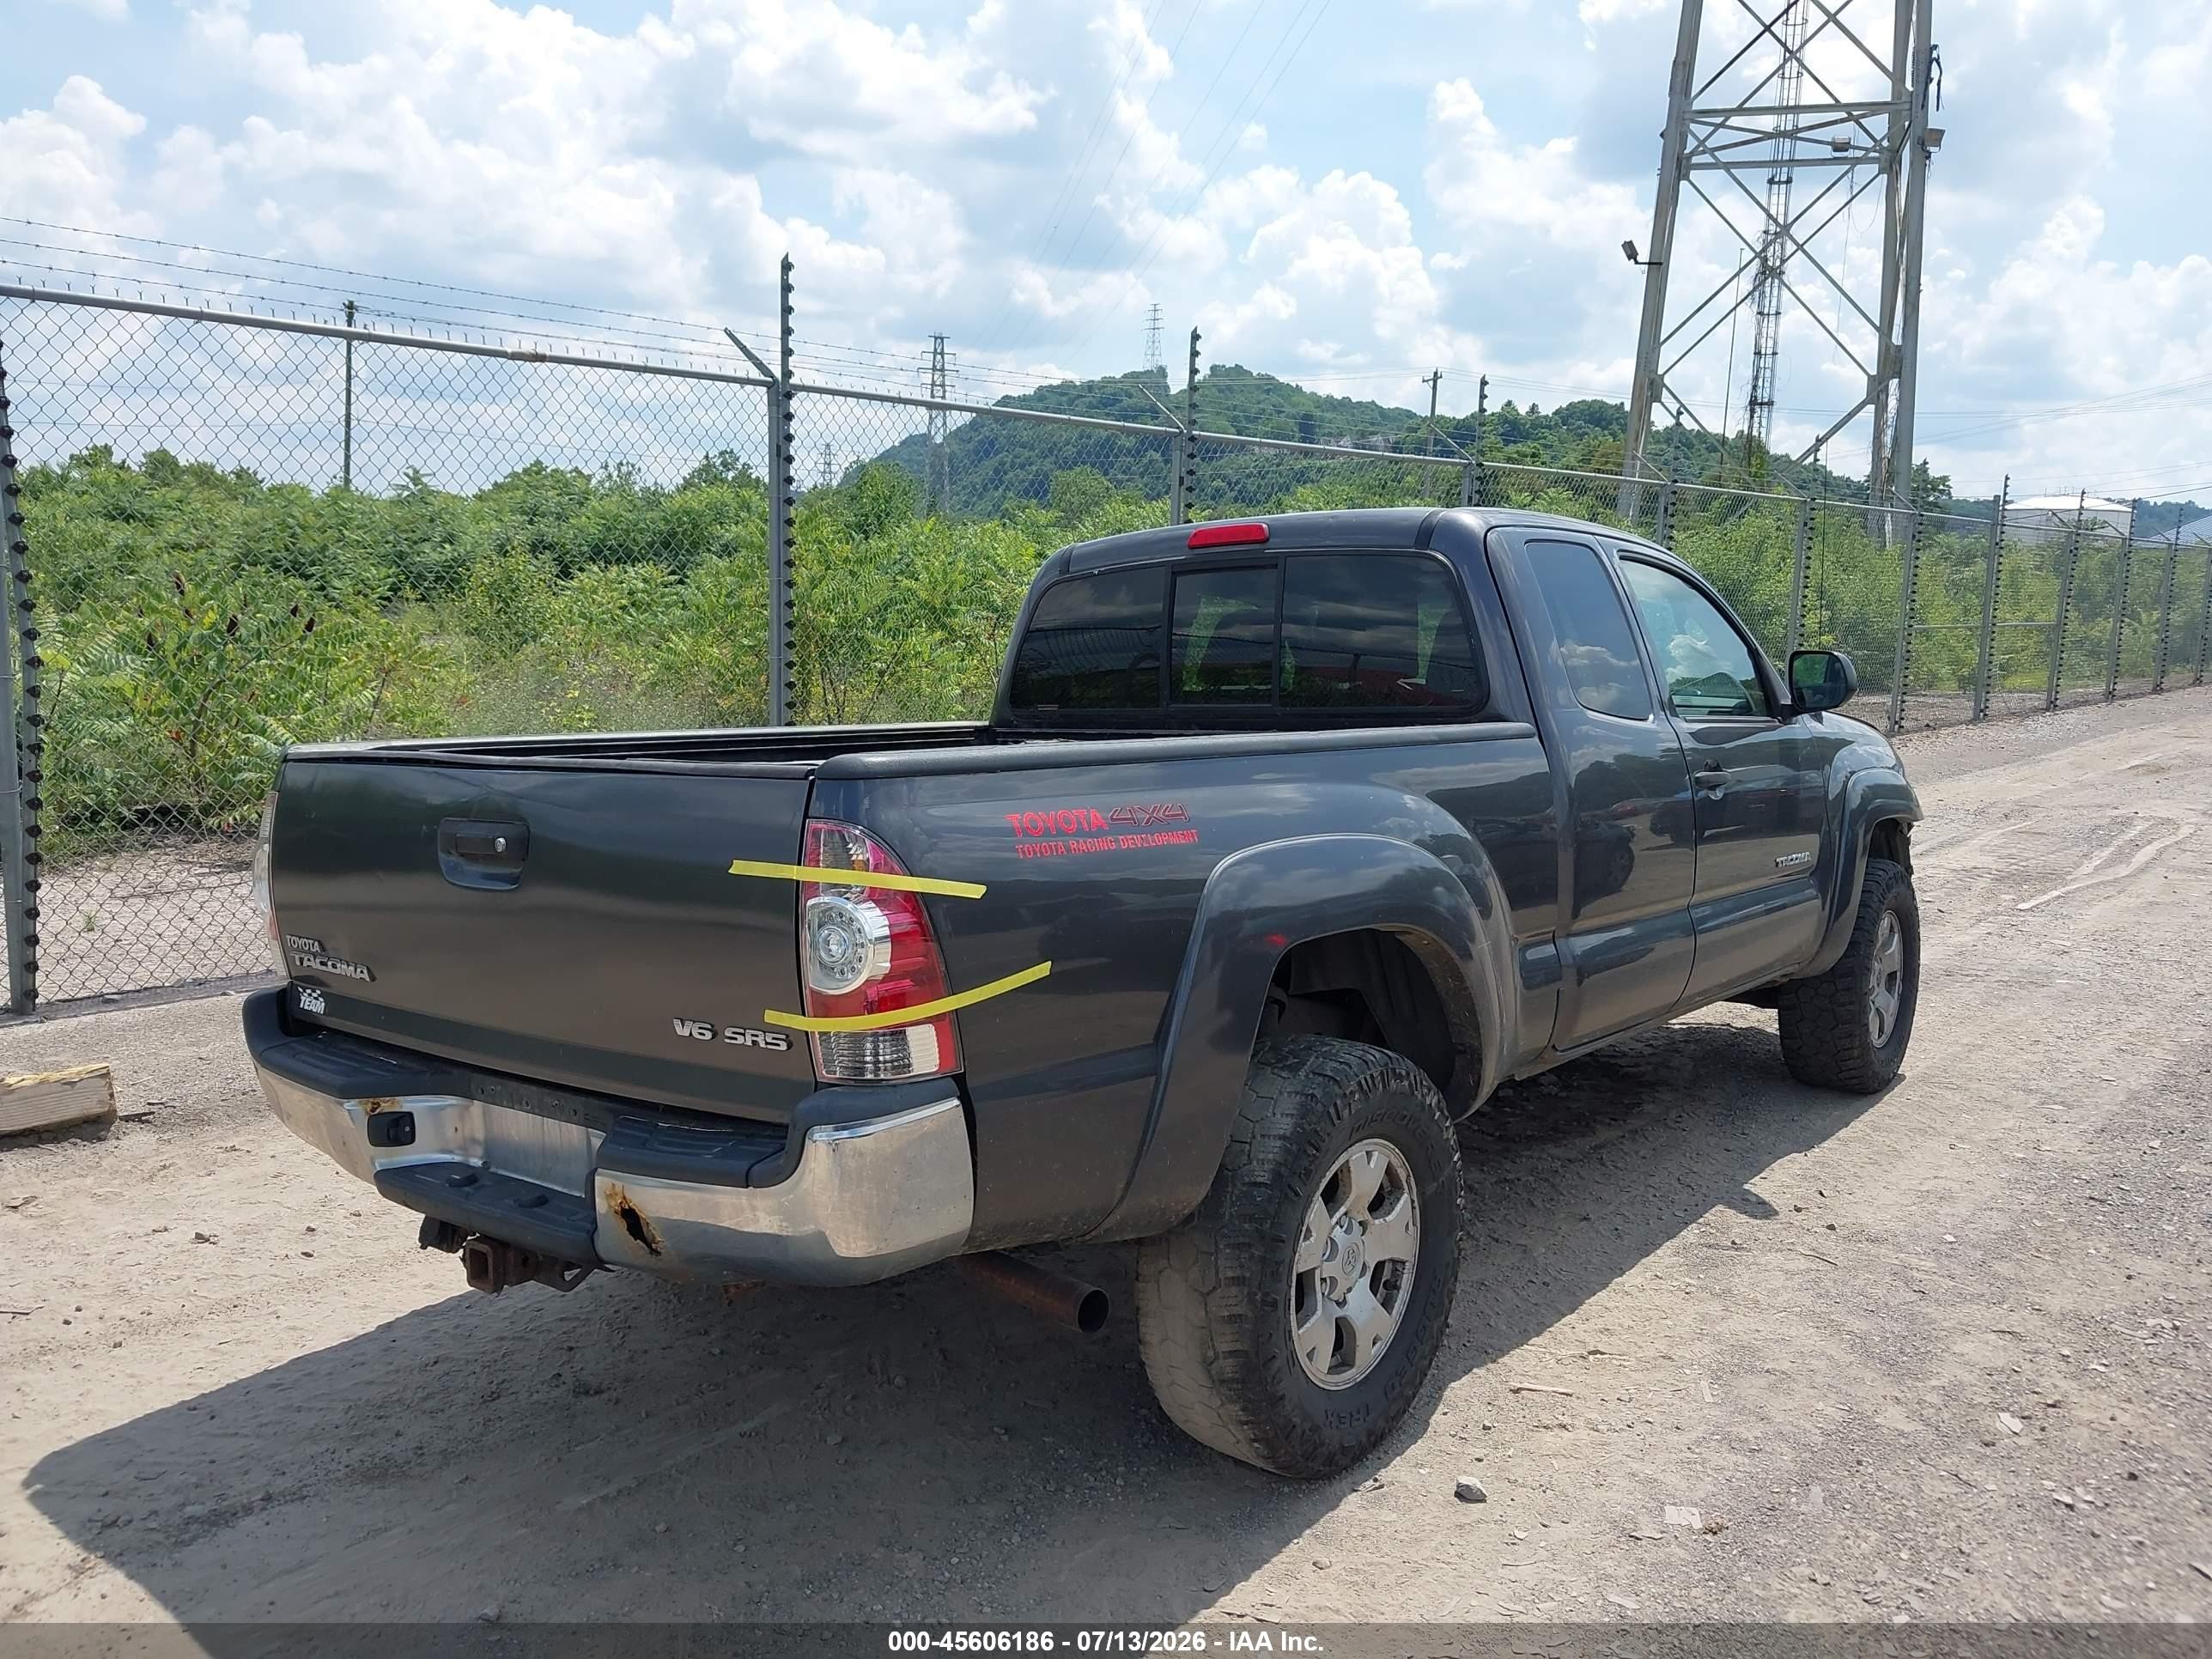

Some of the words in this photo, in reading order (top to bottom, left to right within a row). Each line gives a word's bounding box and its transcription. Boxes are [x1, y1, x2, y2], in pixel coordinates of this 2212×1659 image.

[1005, 809, 1109, 838] TOYOTA
[1016, 842, 1066, 860] TOYOTA
[1071, 836, 1115, 854] RACING
[1119, 830, 1198, 850] DEVELOPMENT
[286, 934, 322, 953] TOYOTA
[290, 951, 372, 982] TACOMA
[299, 996, 325, 1014] TEAM
[673, 1018, 714, 1041] V6
[724, 1027, 787, 1051] SR5
